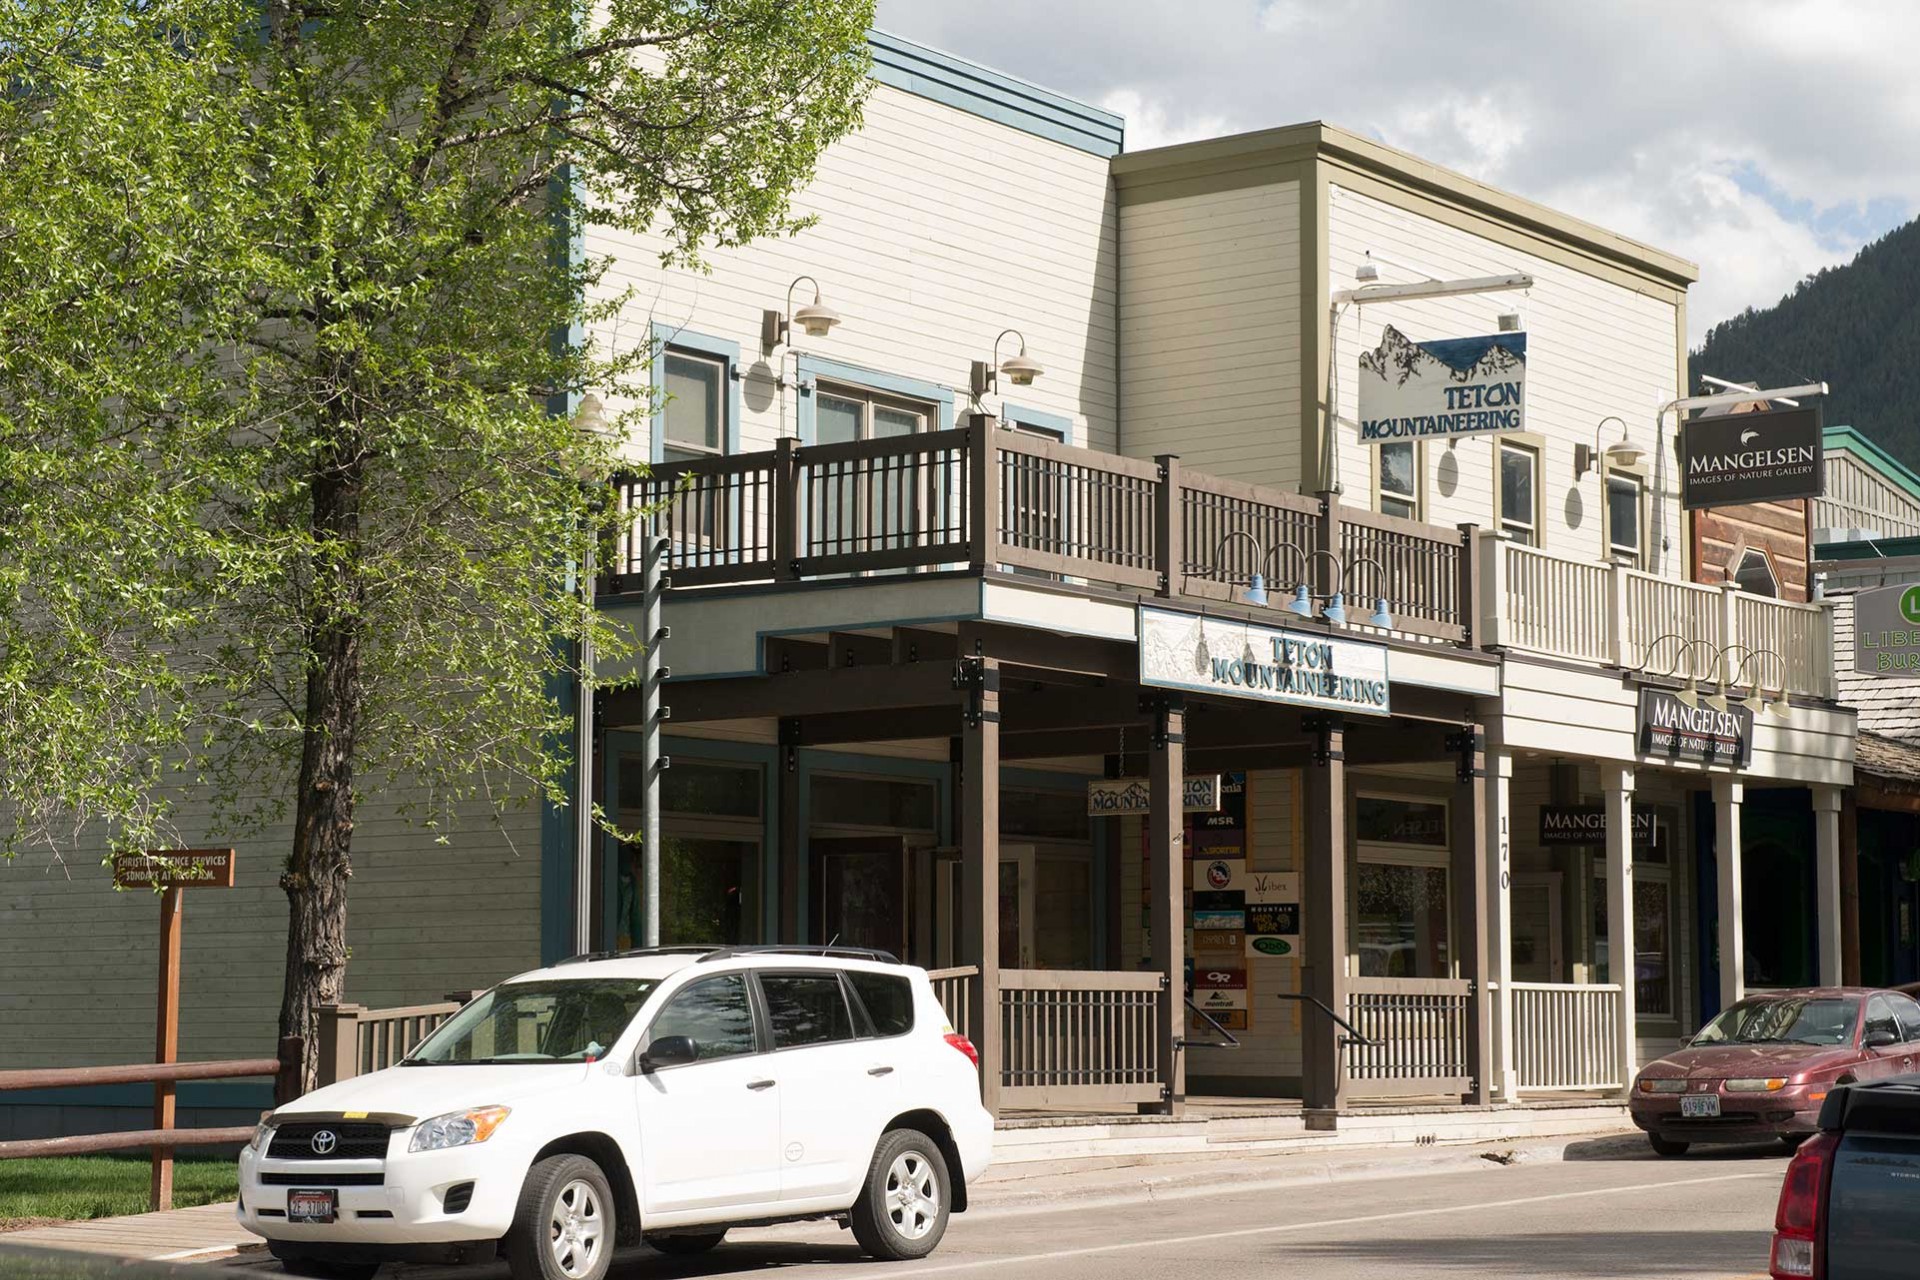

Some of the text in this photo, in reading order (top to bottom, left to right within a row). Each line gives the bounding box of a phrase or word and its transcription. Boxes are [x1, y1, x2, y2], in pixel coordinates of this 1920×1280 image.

[1444, 382, 1521, 410] TETON
[1361, 409, 1520, 439] MOUNTAINEERING
[1689, 446, 1815, 474] MANGELSEN
[1690, 466, 1813, 485] IMAGES OF NATURE GALLERY
[1270, 636, 1333, 670] TETON
[1211, 657, 1386, 706] MOUNTAINEERING
[1653, 697, 1744, 738] MANGELSEN
[1652, 733, 1740, 755] IMAGES OF NATURE GALLERY
[1093, 794, 1212, 810] MOUNTARING
[1207, 816, 1234, 825] MSR
[1544, 813, 1650, 829] MANGEEN
[161, 870, 172, 881] AT
[1207, 971, 1231, 983] OR
